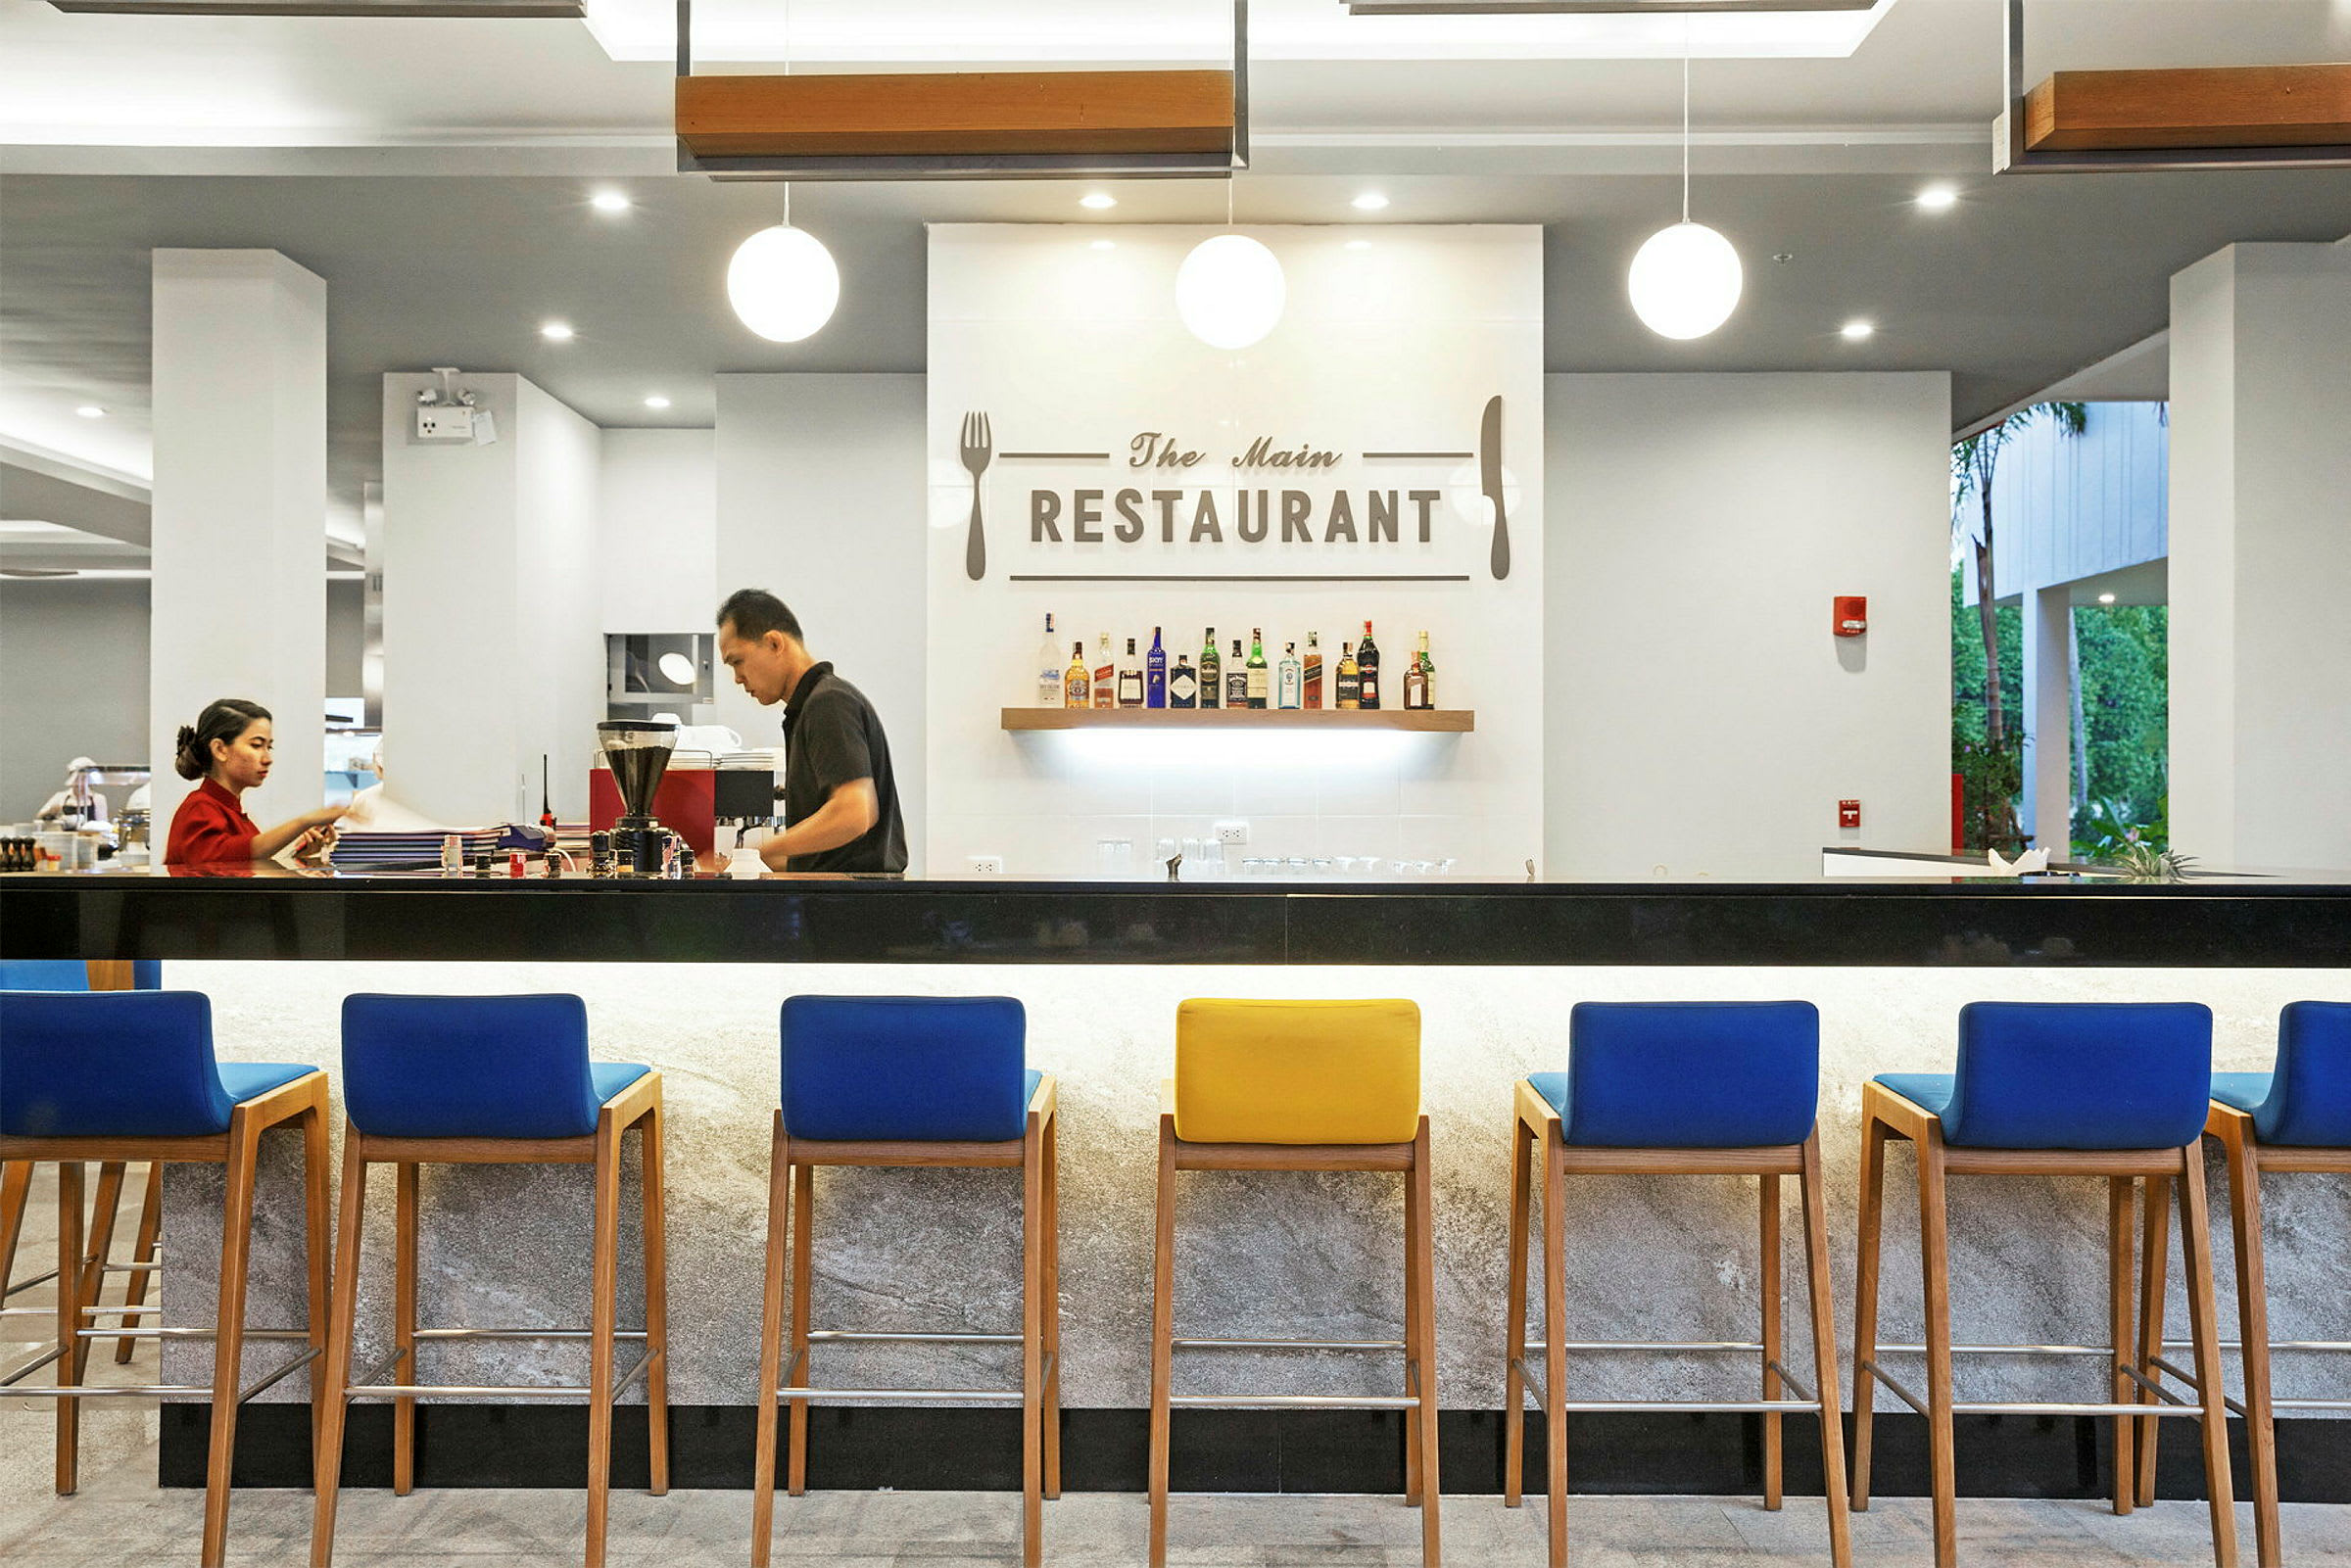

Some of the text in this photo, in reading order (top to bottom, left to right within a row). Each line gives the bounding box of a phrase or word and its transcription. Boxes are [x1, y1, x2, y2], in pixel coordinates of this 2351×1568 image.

[1128, 432, 1343, 468] The Main
[1031, 488, 1441, 543] RESTAURANT
